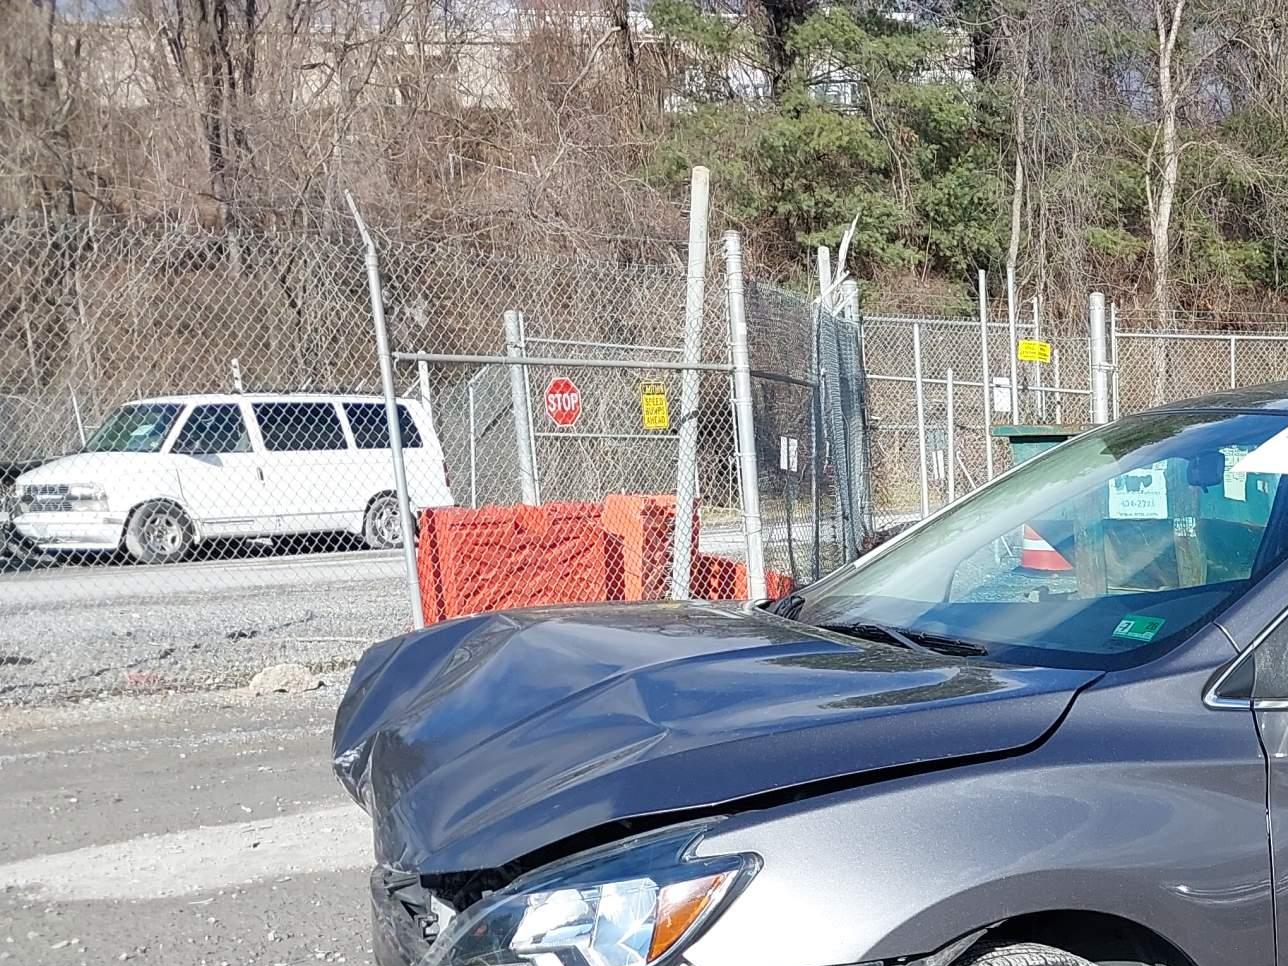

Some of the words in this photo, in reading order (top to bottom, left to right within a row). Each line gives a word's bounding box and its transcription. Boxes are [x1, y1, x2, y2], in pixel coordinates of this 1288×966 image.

[547, 393, 579, 411] STOP
[645, 397, 664, 406] SPEED
[646, 415, 666, 425] AHEAD
